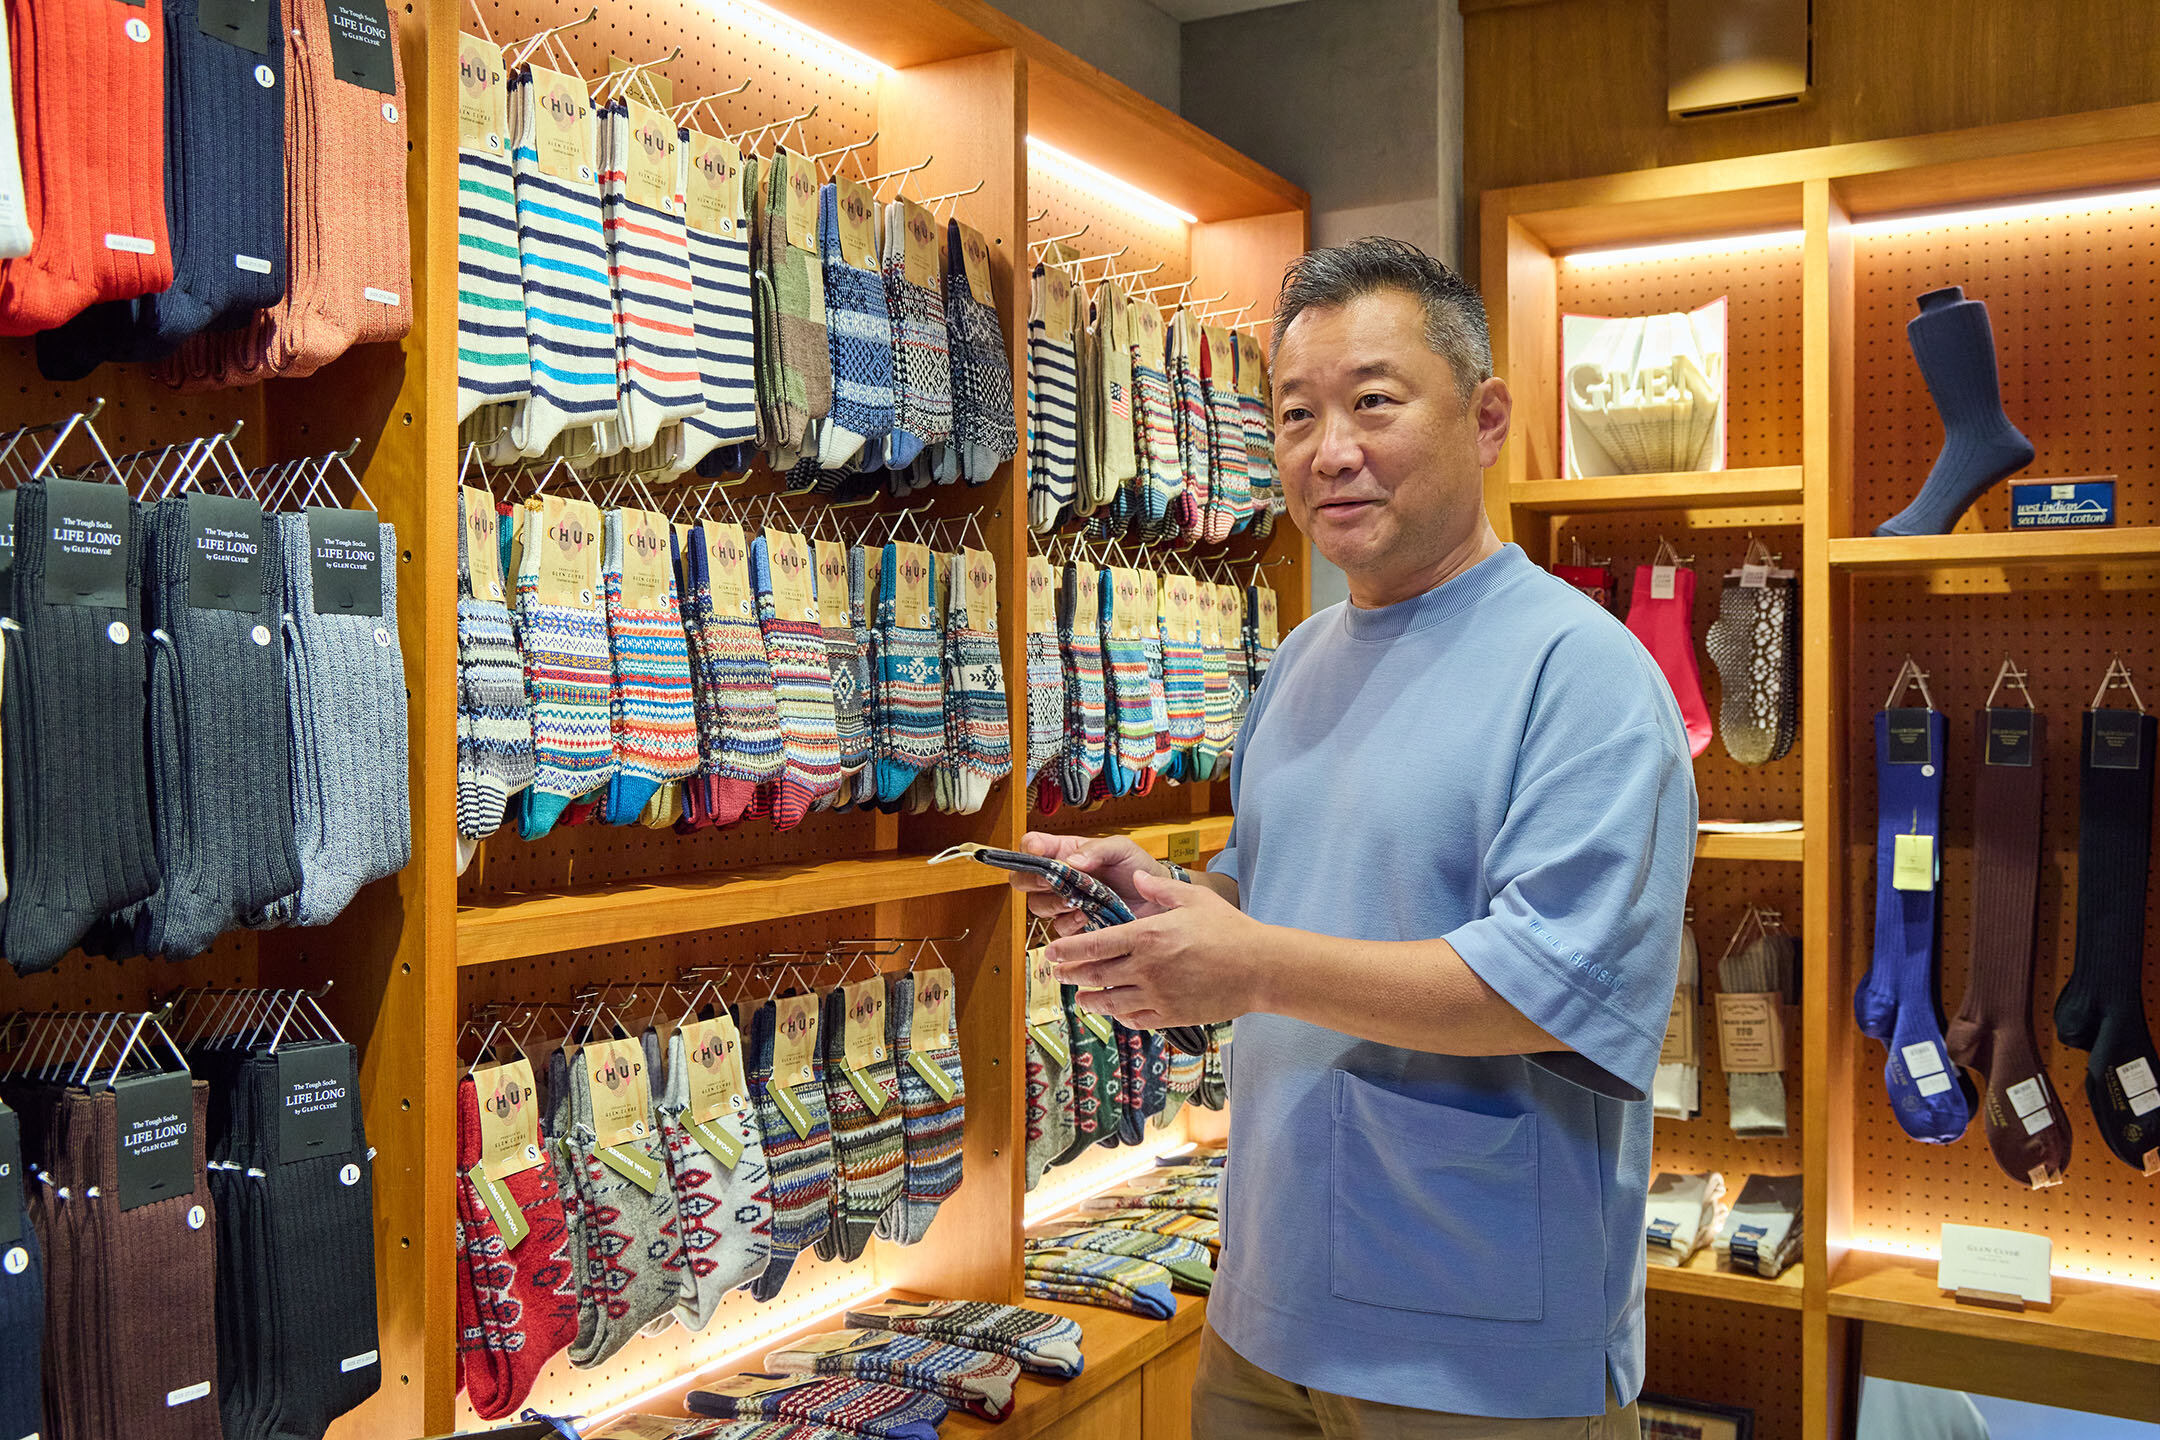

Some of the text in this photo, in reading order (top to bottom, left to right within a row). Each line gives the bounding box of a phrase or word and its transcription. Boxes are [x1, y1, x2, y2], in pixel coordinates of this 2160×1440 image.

[136, 24, 146, 38] L
[333, 14, 387, 39] LIFE LONG
[348, 32, 363, 42] GLEN
[363, 37, 380, 46] CLYDE
[260, 69, 271, 82] L
[460, 62, 500, 86] HUP
[540, 96, 586, 119] CHUP
[387, 108, 397, 121] L
[490, 135, 498, 148] S
[634, 128, 675, 155] CHUP
[582, 167, 589, 179] S
[695, 156, 736, 178] CHUP
[790, 175, 816, 196] CHUP
[665, 198, 672, 211] S
[841, 199, 872, 220] CHUP
[723, 220, 730, 232] S
[908, 220, 935, 241] CHUP
[806, 235, 813, 247] S
[963, 239, 986, 261] CHUP
[867, 256, 875, 266] S
[929, 277, 936, 288] S
[1567, 352, 1722, 413] GLEN
[2017, 500, 2078, 512] west indian
[63, 517, 112, 529] The Tough Socks
[469, 514, 494, 534] CHUP
[2017, 512, 2106, 525] sea island cotton
[54, 528, 121, 545] LIFE LONG
[205, 527, 249, 539] The Tough Socks
[548, 526, 594, 545] CHUP
[0, 535, 14, 546] LI
[197, 537, 258, 555] LIFE LONG
[335, 539, 352, 547] Tough
[628, 533, 667, 551] CHUP
[63, 545, 70, 553] by
[71, 546, 91, 554] GLEN
[317, 547, 376, 561] LIFE LONG
[711, 545, 744, 561] CHUP
[213, 553, 230, 561] GLEN
[774, 552, 807, 569] CHUP
[820, 563, 845, 577] CHUP
[869, 570, 881, 580] CH
[900, 566, 927, 579] CHUP
[969, 570, 993, 584] CHUP
[1030, 576, 1049, 587] HUP
[493, 585, 499, 596] S
[582, 591, 590, 603] S
[660, 595, 667, 607] S
[742, 602, 748, 613] S
[1200, 596, 1215, 607] HUP
[807, 609, 814, 620] S
[841, 613, 847, 624] S
[921, 615, 927, 626] S
[988, 620, 995, 631] S
[112, 626, 125, 639] M
[256, 629, 268, 642] M
[377, 632, 389, 644] M
[1528, 919, 1624, 993] HELLY HANSEN
[1034, 966, 1052, 979] CHU
[918, 989, 948, 1001] CHUP
[850, 1000, 882, 1019] CHUP
[779, 1017, 815, 1034] CHUP
[691, 1040, 734, 1063] CHUP
[875, 1047, 882, 1059] S
[594, 1063, 641, 1084] CHUP
[802, 1065, 809, 1078] S
[305, 1081, 322, 1089] Tough
[286, 1087, 346, 1107] LIFE LONG
[485, 1087, 532, 1112] CHUP
[732, 1096, 740, 1107] S
[301, 1104, 319, 1113] GLEN
[319, 1101, 338, 1110] CLYDE
[133, 1121, 144, 1129] The
[144, 1117, 162, 1126] Tough
[794, 1109, 807, 1129] WOOL
[124, 1122, 187, 1147] LIFE LONG
[636, 1122, 643, 1135] S
[141, 1143, 160, 1153] GLEN
[159, 1138, 179, 1149] CLYDE
[716, 1138, 734, 1156] WOOL
[528, 1146, 536, 1159] S
[346, 1168, 357, 1181] L
[634, 1162, 652, 1180] WOOL
[192, 1211, 203, 1224] L
[504, 1210, 518, 1236] WOOL
[11, 1253, 25, 1268] L
